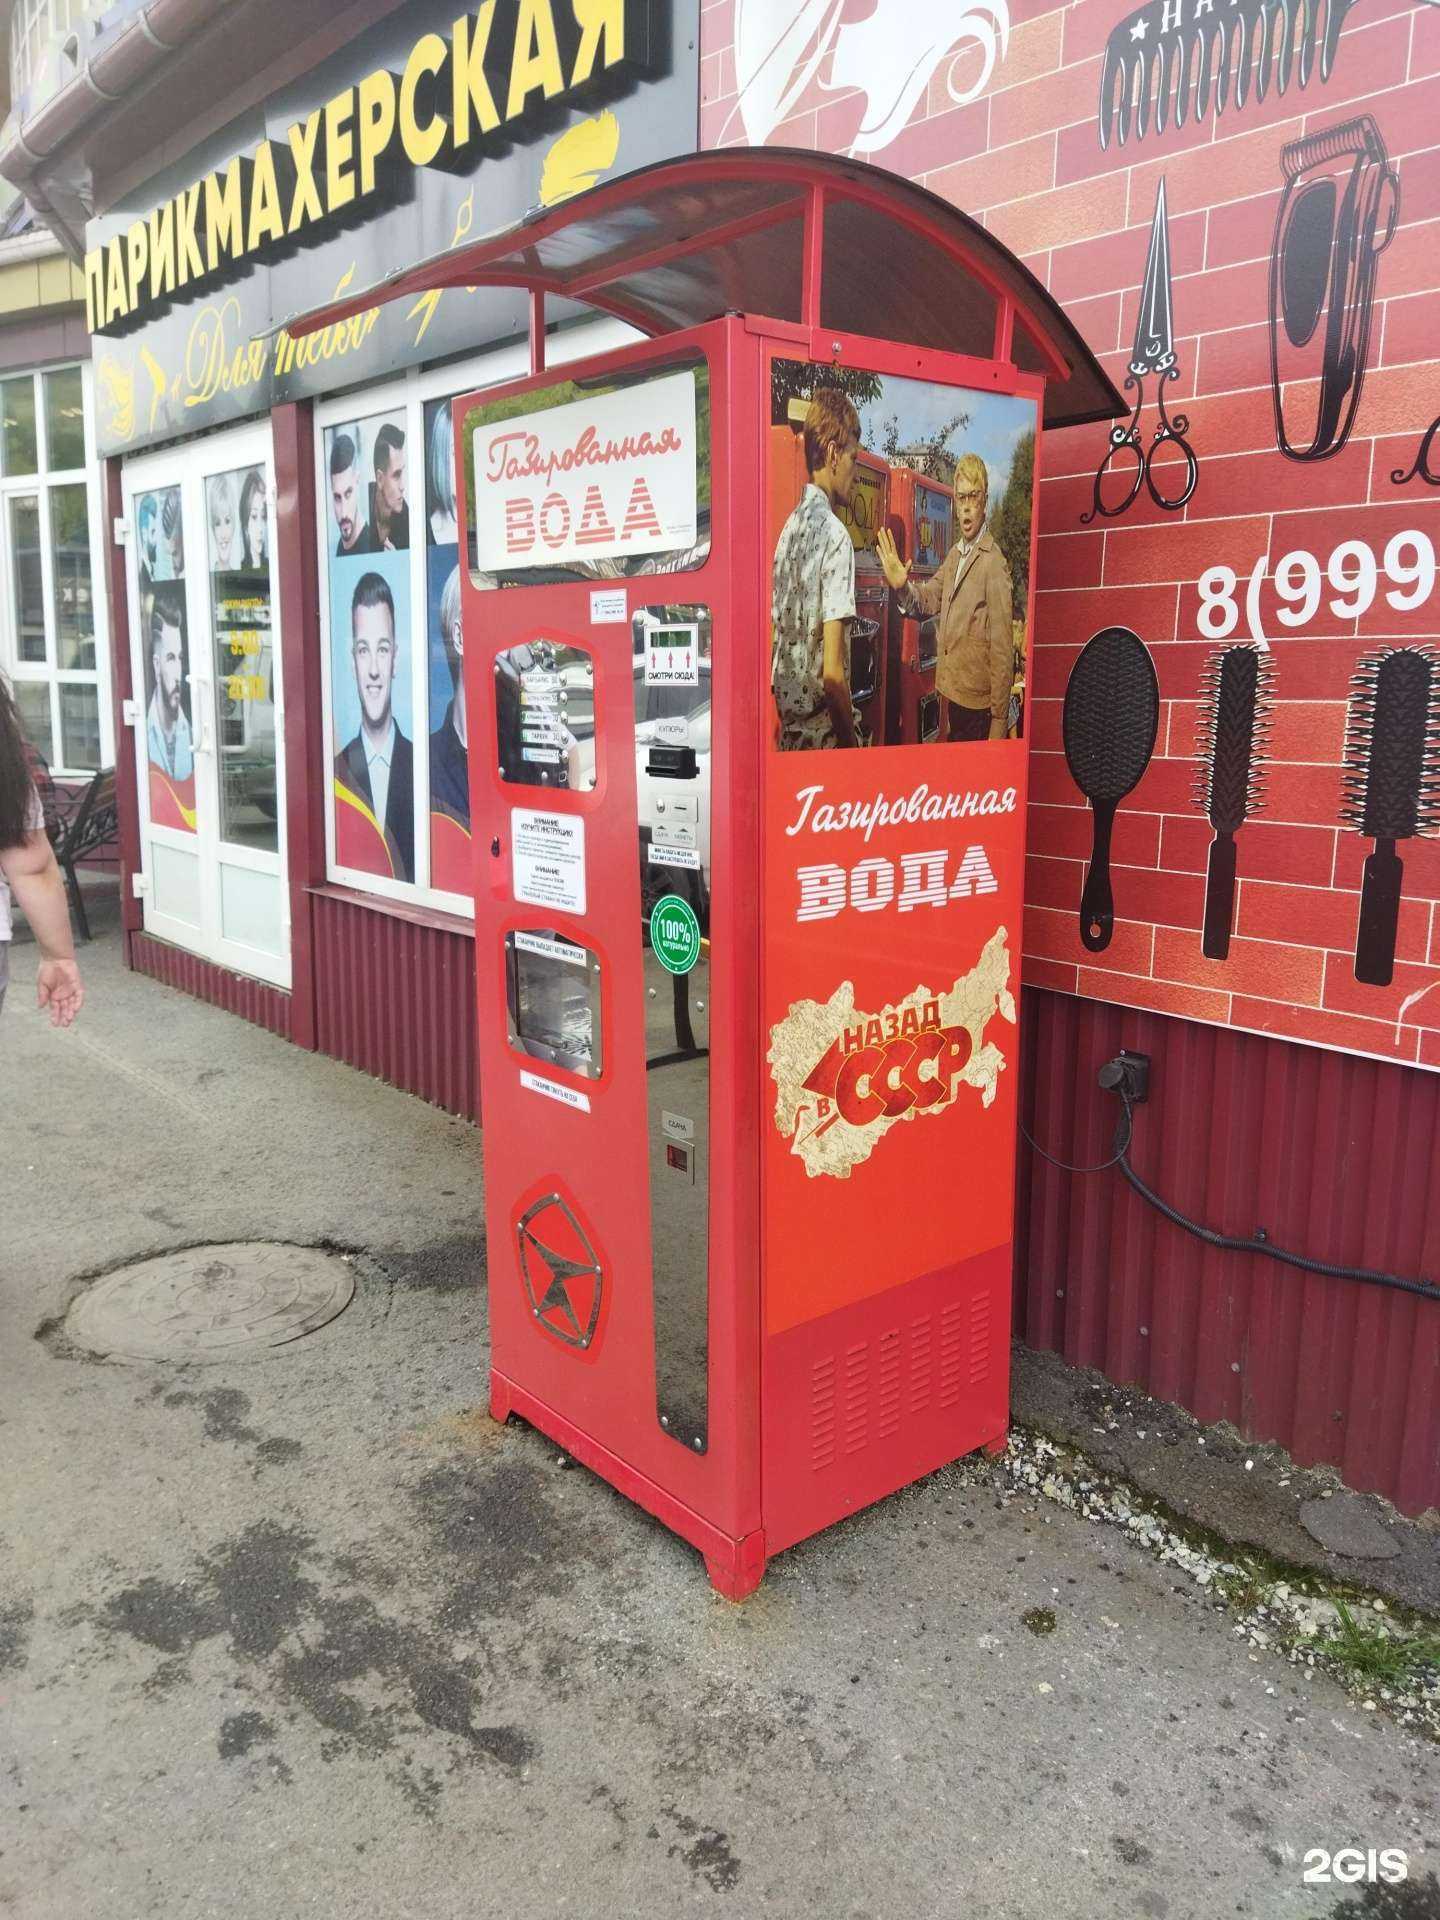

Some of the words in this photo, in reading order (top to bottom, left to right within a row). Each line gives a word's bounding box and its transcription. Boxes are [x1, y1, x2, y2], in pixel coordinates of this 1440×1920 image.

[84, 0, 626, 334] ПАРИКМАХЕРСКАЯ
[486, 425, 682, 487] Газированная
[505, 477, 662, 554] ВОДА
[1196, 529, 1436, 651] 8(999
[648, 671, 673, 680] СМОТРИ
[785, 782, 1018, 843] Газированная
[796, 844, 999, 922] ВОДА
[660, 919, 691, 944] 100%
[842, 1000, 941, 1056] НАЗАД
[835, 1025, 973, 1127] СССР
